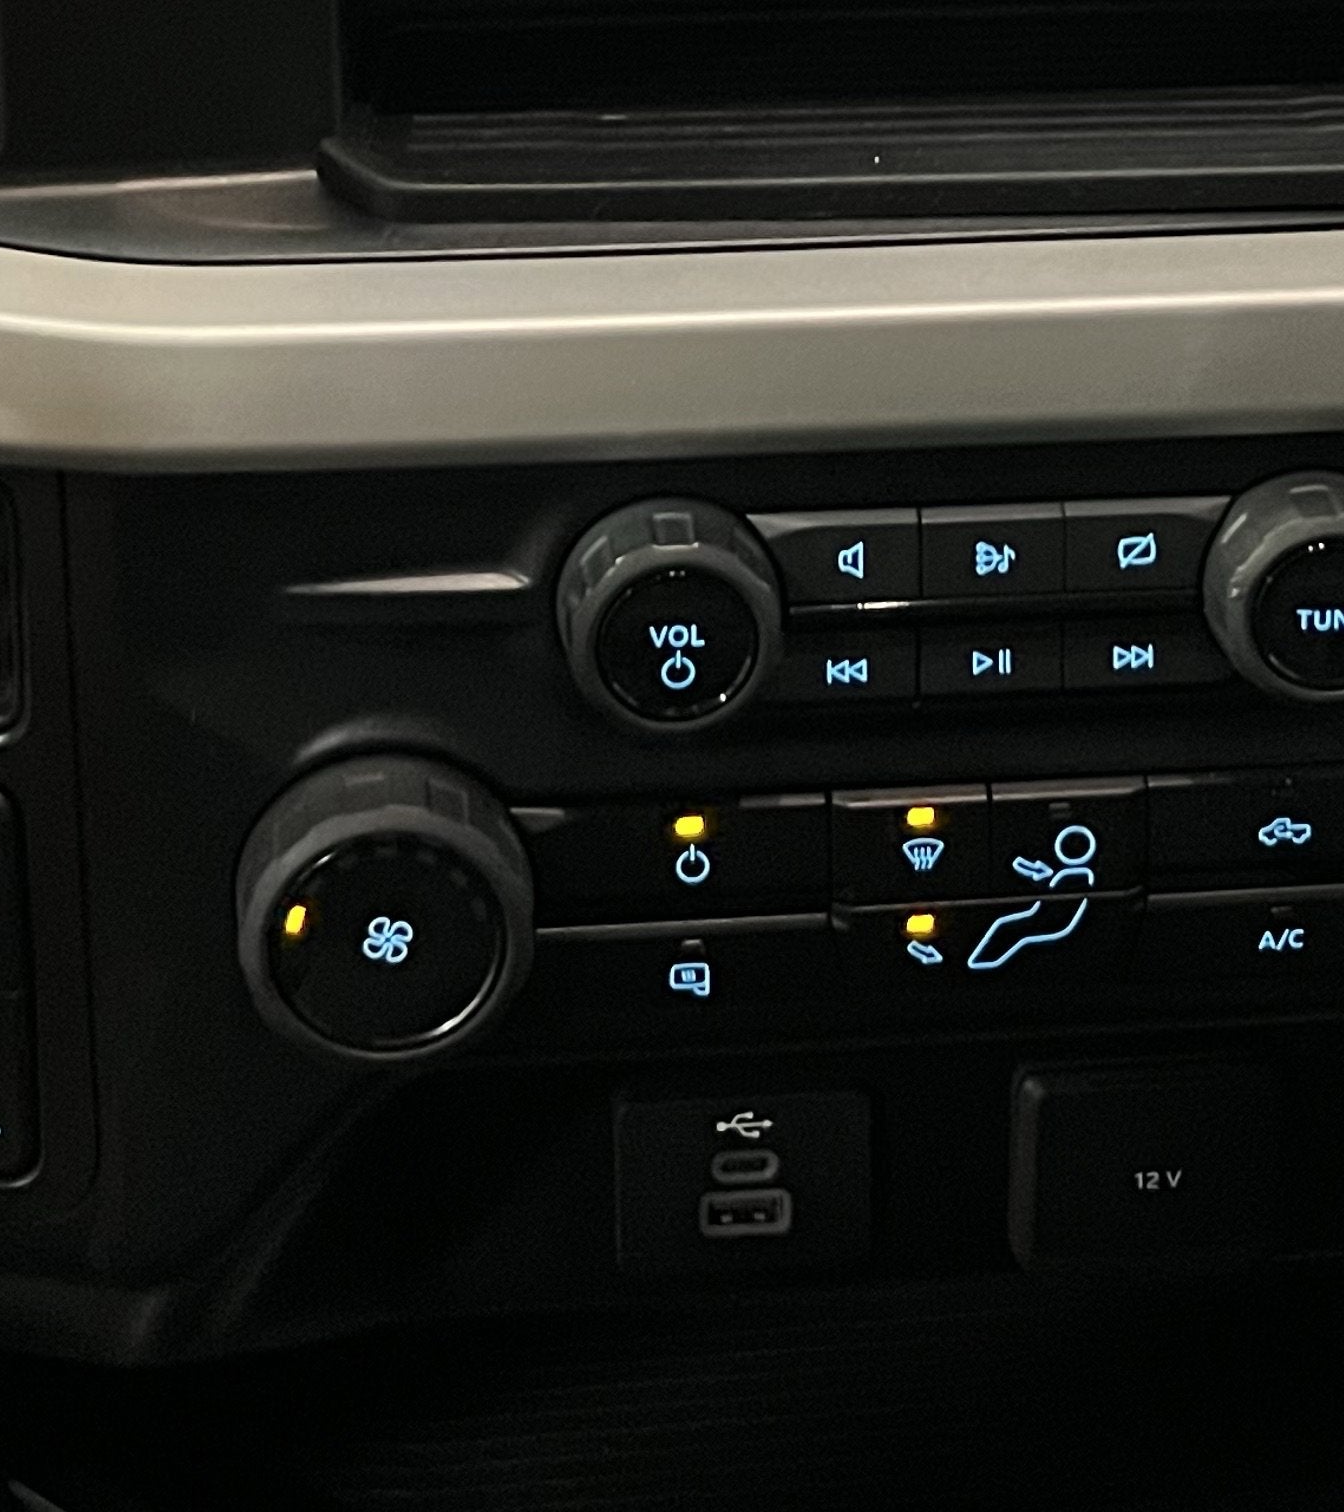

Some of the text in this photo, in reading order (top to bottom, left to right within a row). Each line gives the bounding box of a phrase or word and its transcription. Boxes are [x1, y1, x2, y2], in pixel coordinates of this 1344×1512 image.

[649, 623, 706, 650] VOL
[1258, 928, 1305, 951] A/C
[1135, 1170, 1183, 1190] 12 V
